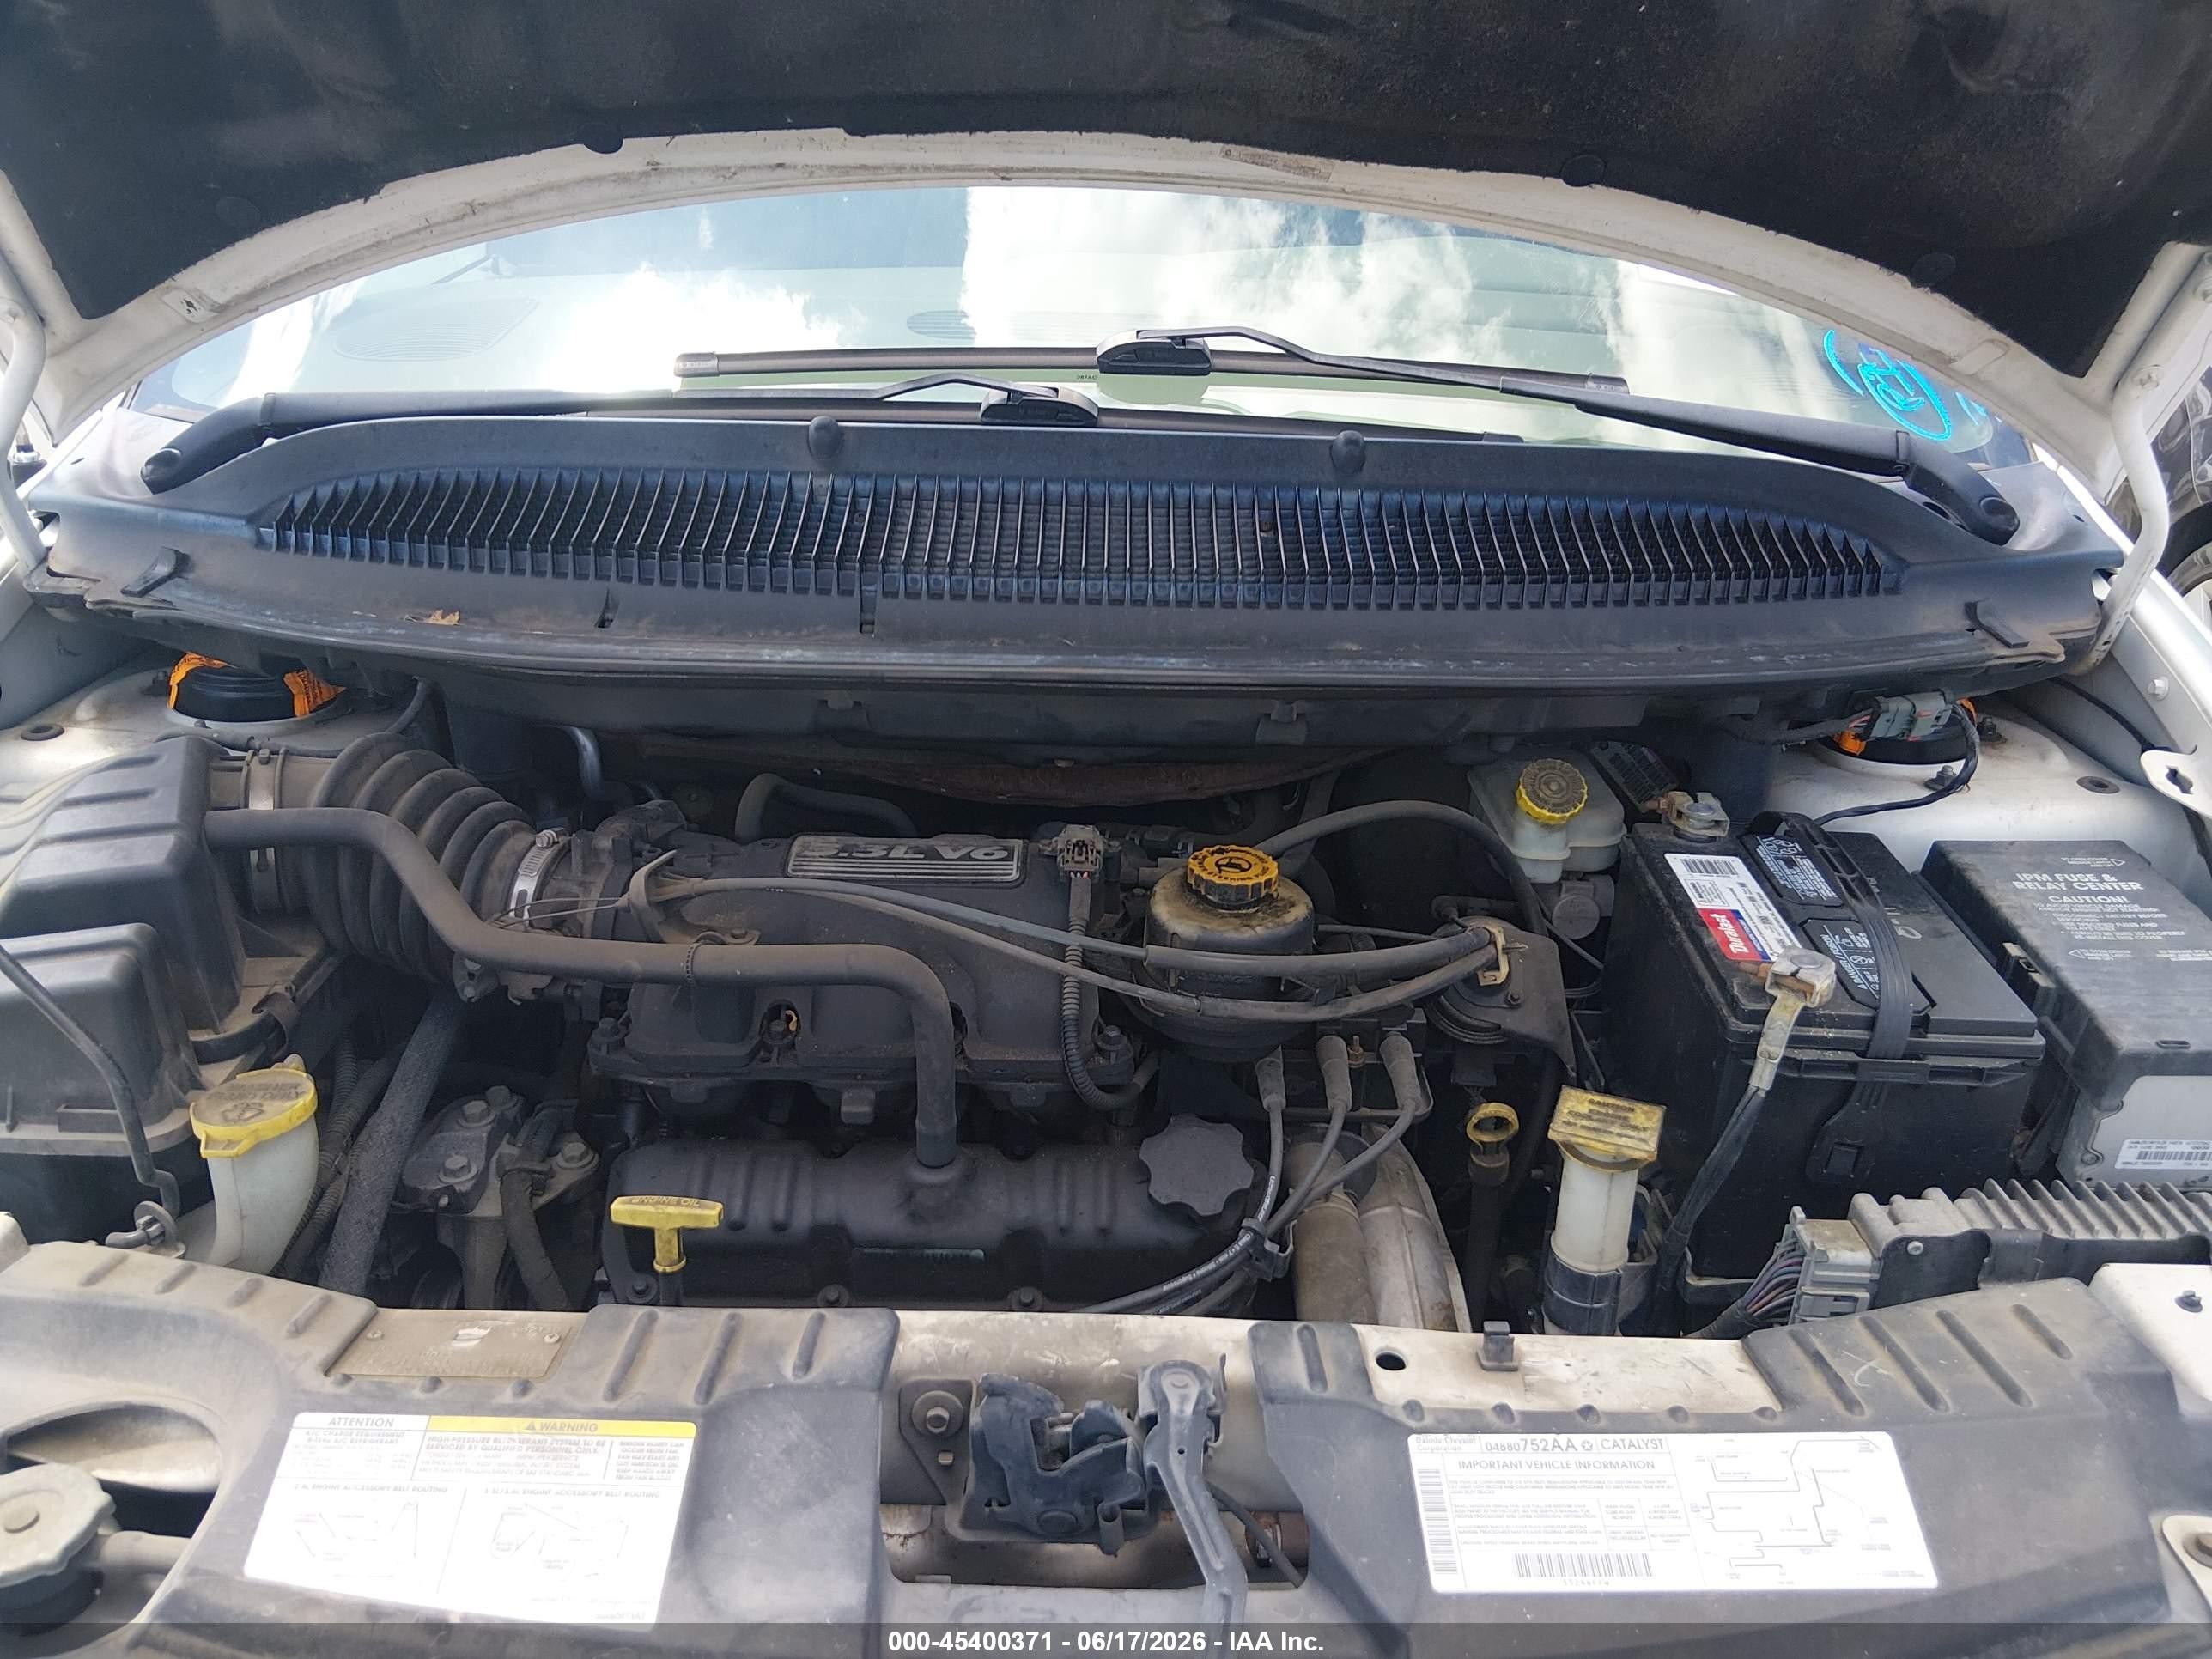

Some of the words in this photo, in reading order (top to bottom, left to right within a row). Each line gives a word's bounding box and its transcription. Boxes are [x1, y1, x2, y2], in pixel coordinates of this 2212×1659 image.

[934, 845, 1008, 860] V6
[2016, 873, 2050, 882] IPM
[2054, 873, 2099, 883] FUSE
[2101, 874, 2118, 883] &
[2012, 881, 2071, 890] RELAY
[2072, 882, 2143, 891] CENTER
[2047, 895, 2130, 903] CAUTION!
[1710, 913, 1750, 955] Duralast
[631, 1196, 678, 1205] ENGINE
[680, 1197, 701, 1207] OIL
[328, 1416, 394, 1427] ATTENTION
[539, 1421, 599, 1433] WARNING
[1486, 1438, 1578, 1452] 04880752AA
[1599, 1437, 1665, 1451] CATALYST
[1459, 1461, 1522, 1470] IMPORTANT
[1525, 1461, 1572, 1470] VEHICLE
[1575, 1461, 1656, 1470] INFORMATION
